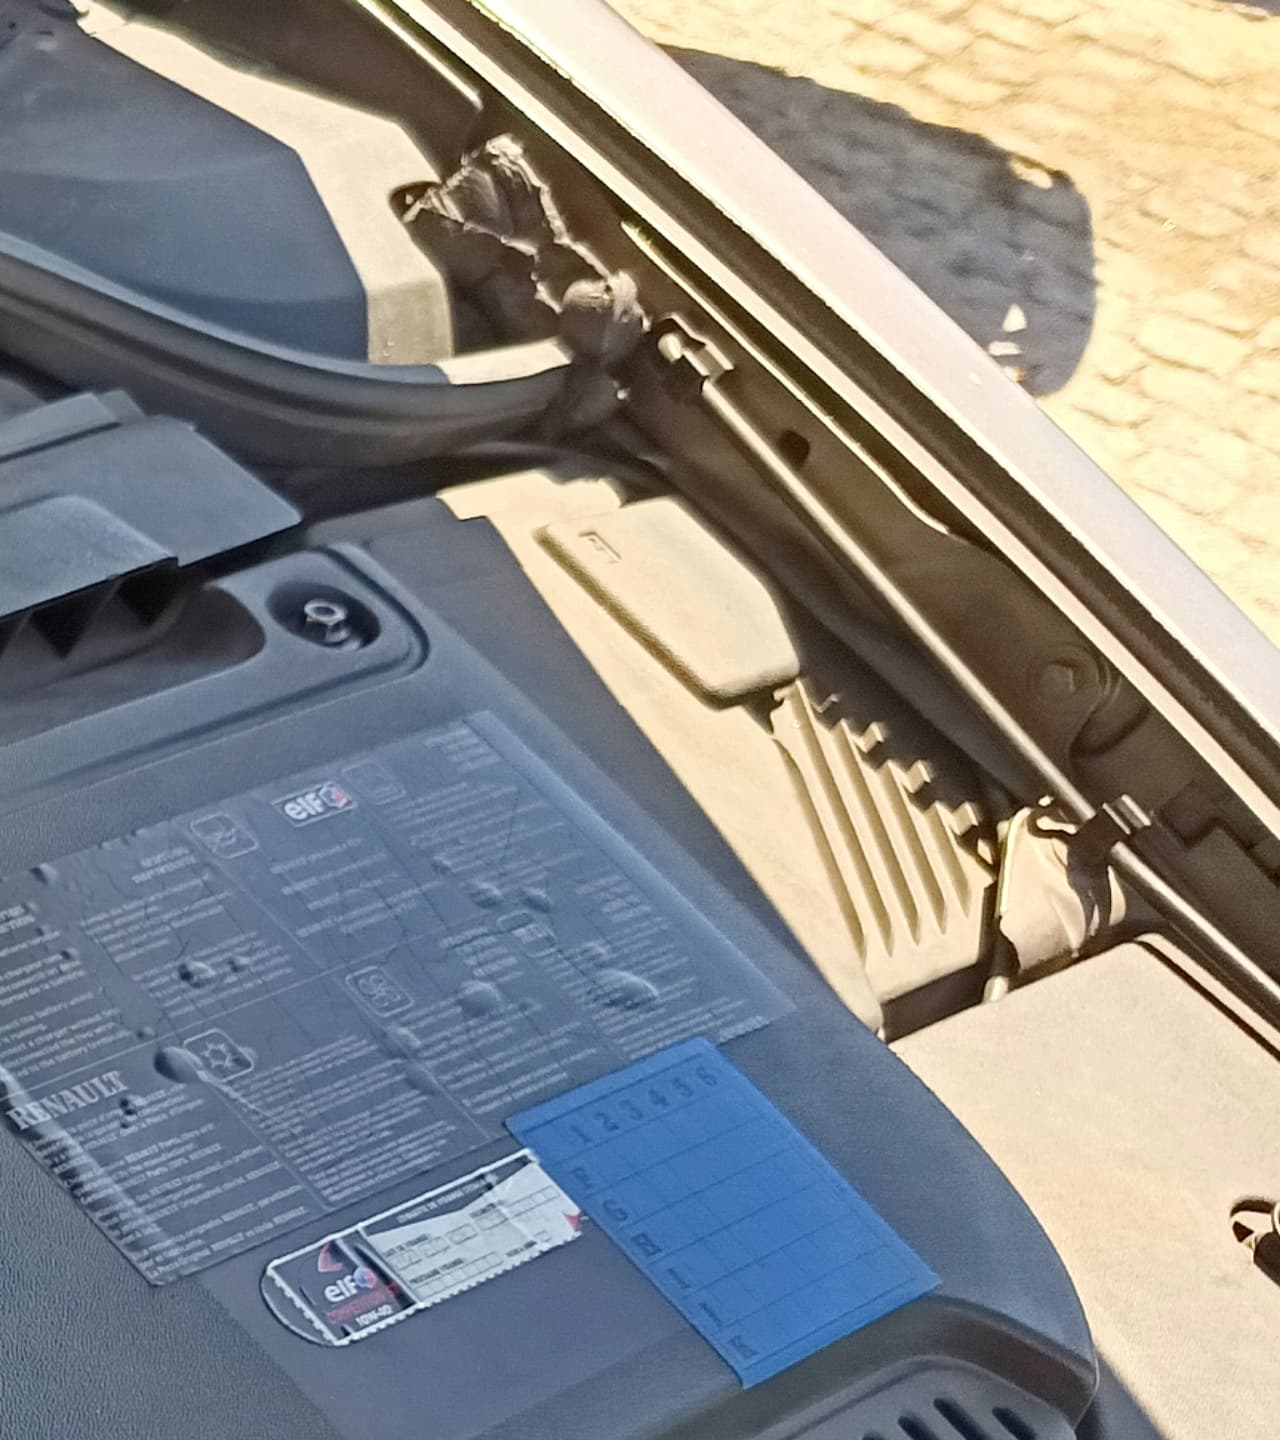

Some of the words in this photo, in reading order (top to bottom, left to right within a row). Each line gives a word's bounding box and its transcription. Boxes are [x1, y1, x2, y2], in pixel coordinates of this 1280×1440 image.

[284, 792, 324, 820] elf
[5, 1070, 129, 1130] RENAULT
[594, 1111, 619, 1132] 2
[620, 1099, 644, 1121] 3
[648, 1087, 670, 1107] 4
[672, 1076, 695, 1097] 5
[696, 1066, 718, 1086] 6
[602, 1199, 629, 1222] G
[324, 1274, 358, 1302] elf
